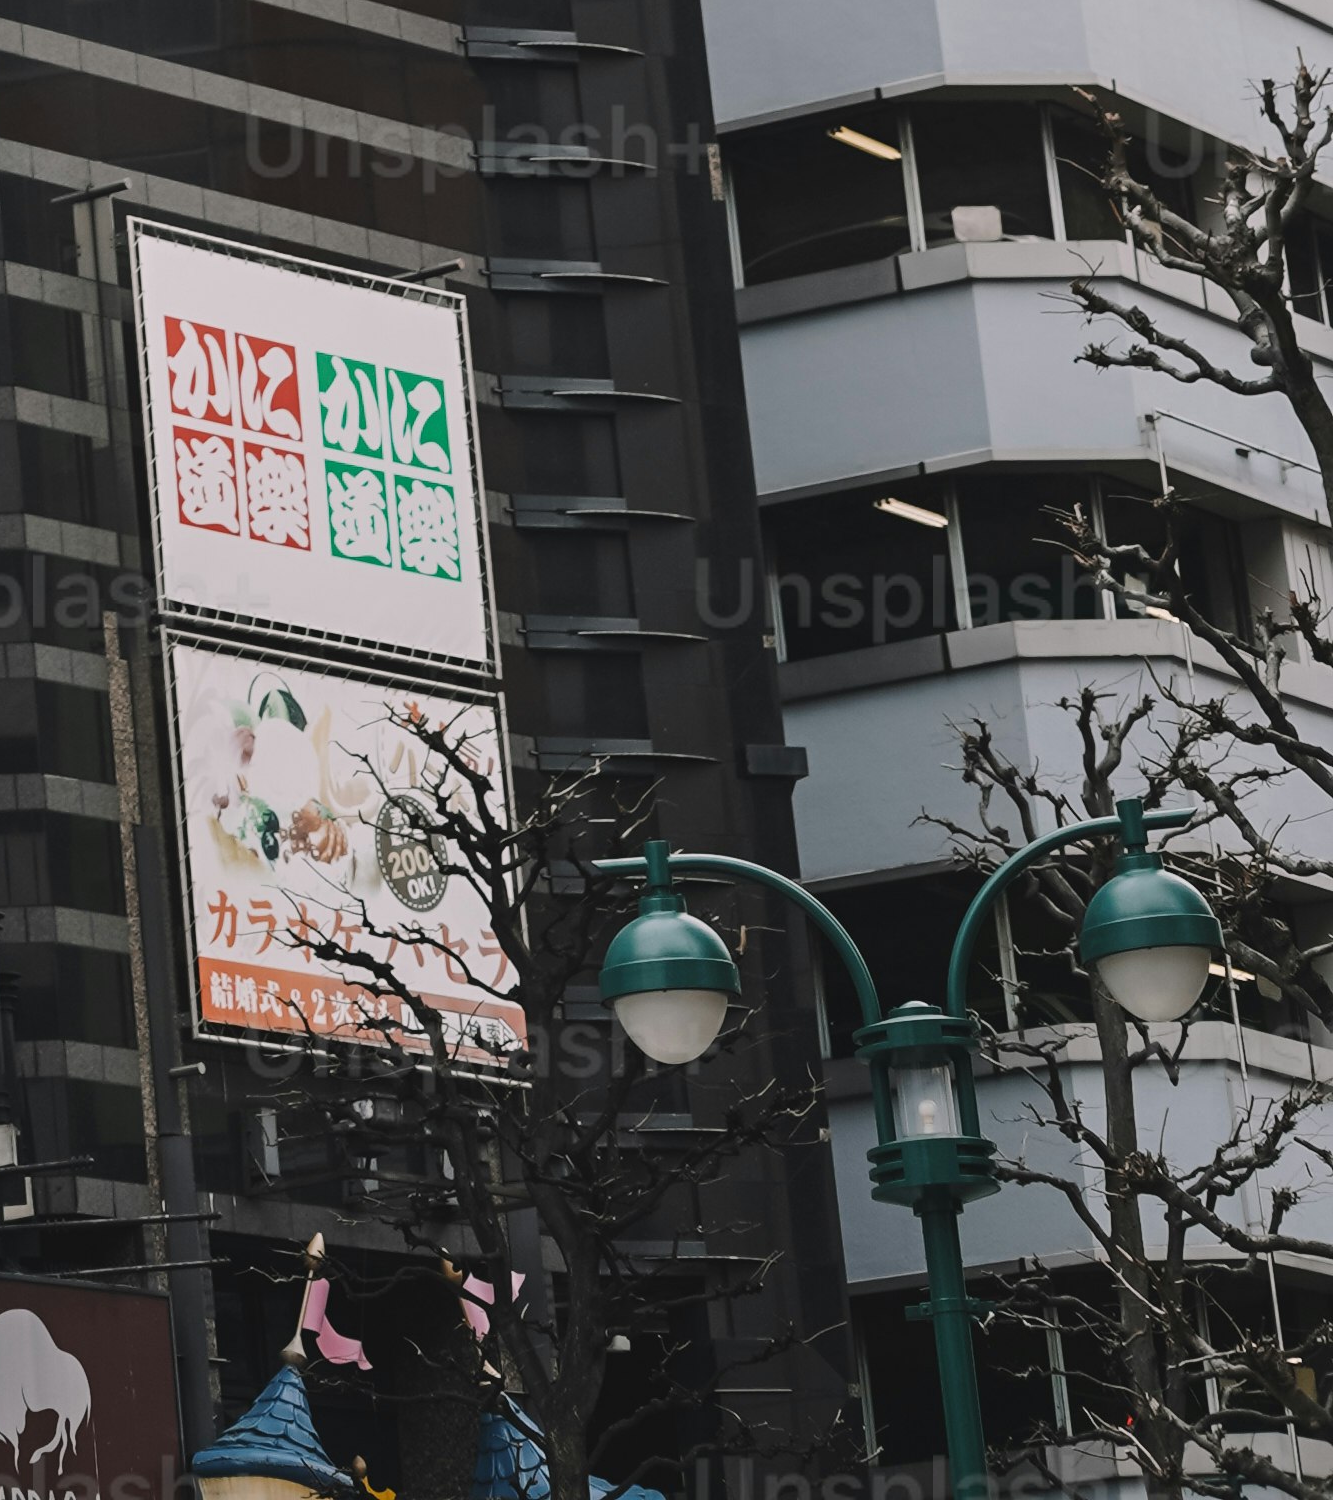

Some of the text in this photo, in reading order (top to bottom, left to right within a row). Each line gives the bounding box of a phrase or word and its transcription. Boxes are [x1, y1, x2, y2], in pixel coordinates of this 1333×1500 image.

[407, 874, 437, 900] OK!
[207, 889, 363, 963] カラオケ
